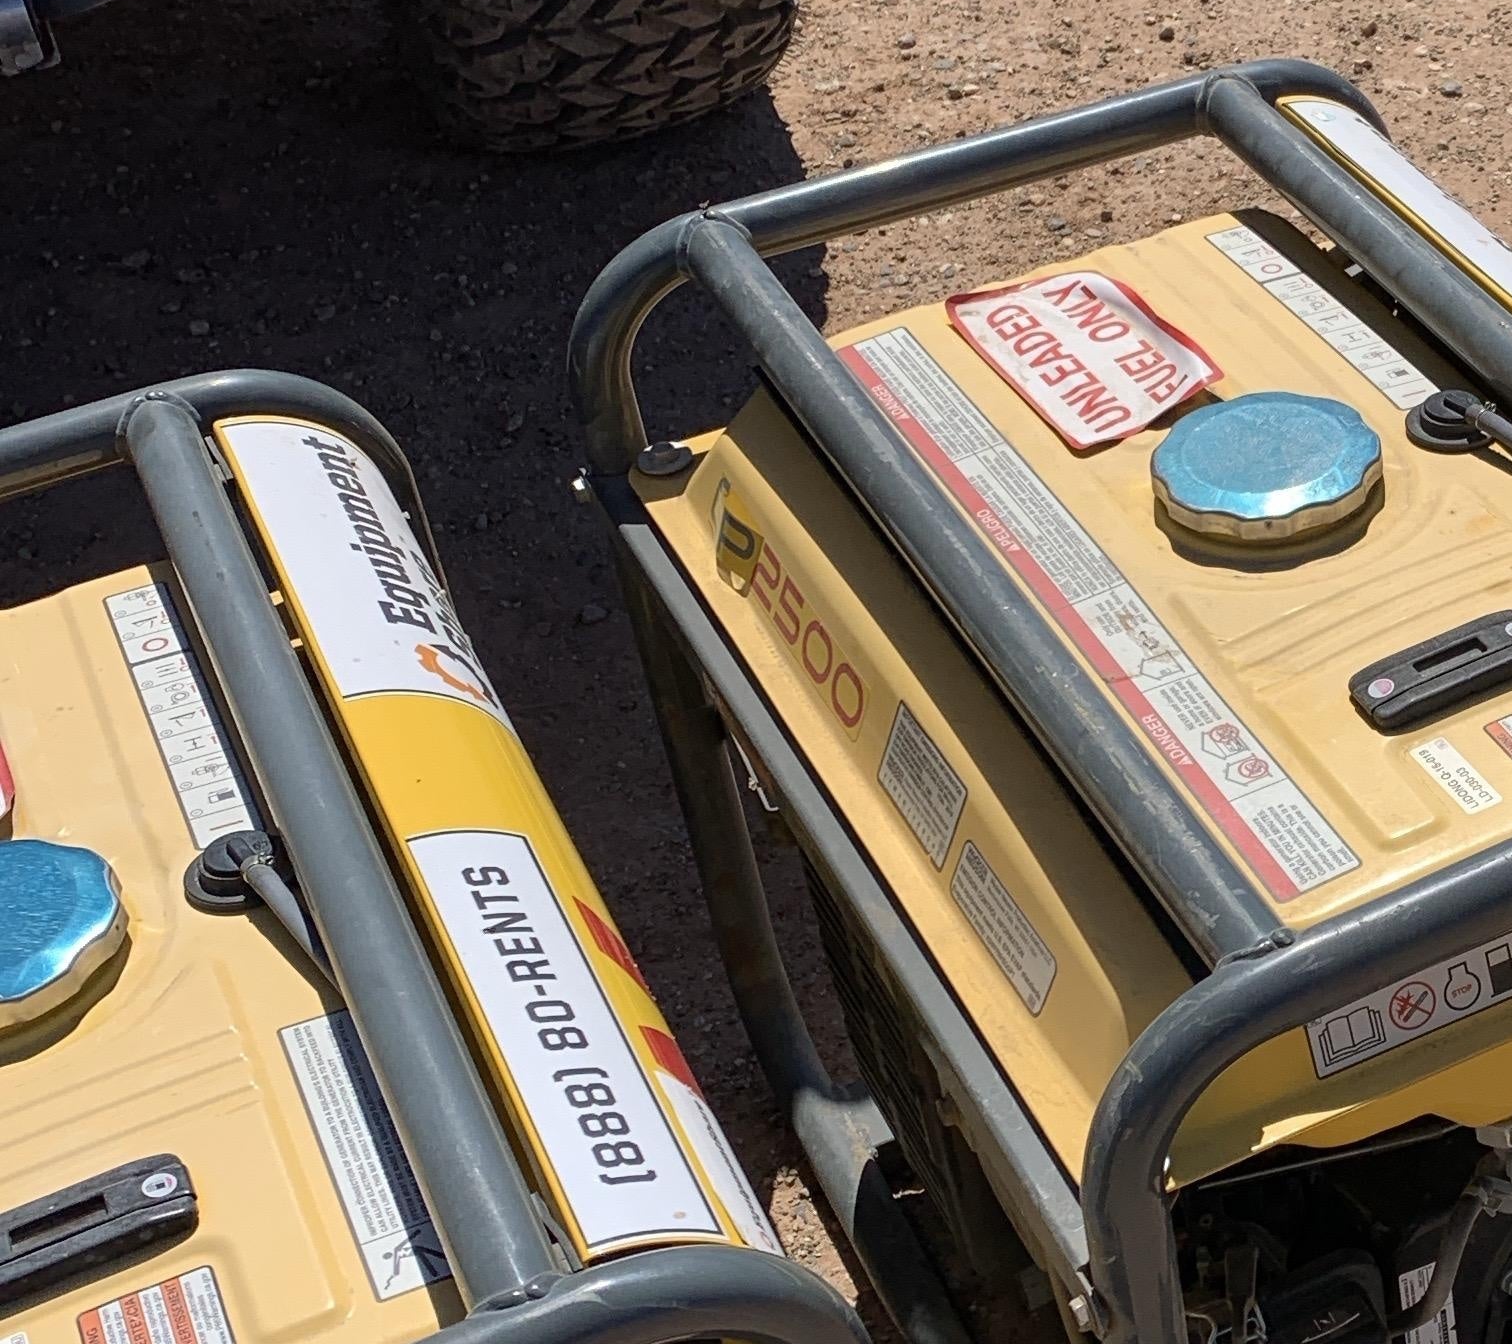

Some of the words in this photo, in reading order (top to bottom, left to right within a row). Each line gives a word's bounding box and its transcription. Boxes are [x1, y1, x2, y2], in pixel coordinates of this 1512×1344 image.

[1042, 280, 1129, 341] ONLY
[986, 304, 1131, 432] UNLEADED
[1114, 339, 1187, 404] FUEL
[871, 383, 905, 416] DANGER
[302, 436, 437, 634] Equipment
[975, 507, 1015, 546] PELIGRO
[718, 507, 863, 728] P2500
[1140, 712, 1185, 758] DANGER
[1445, 778, 1479, 809] LIDONG
[1455, 766, 1493, 802] LD-030-03
[462, 866, 588, 1051] 80-RENTS
[1450, 982, 1473, 999] STOP
[553, 1067, 657, 1186] (888)
